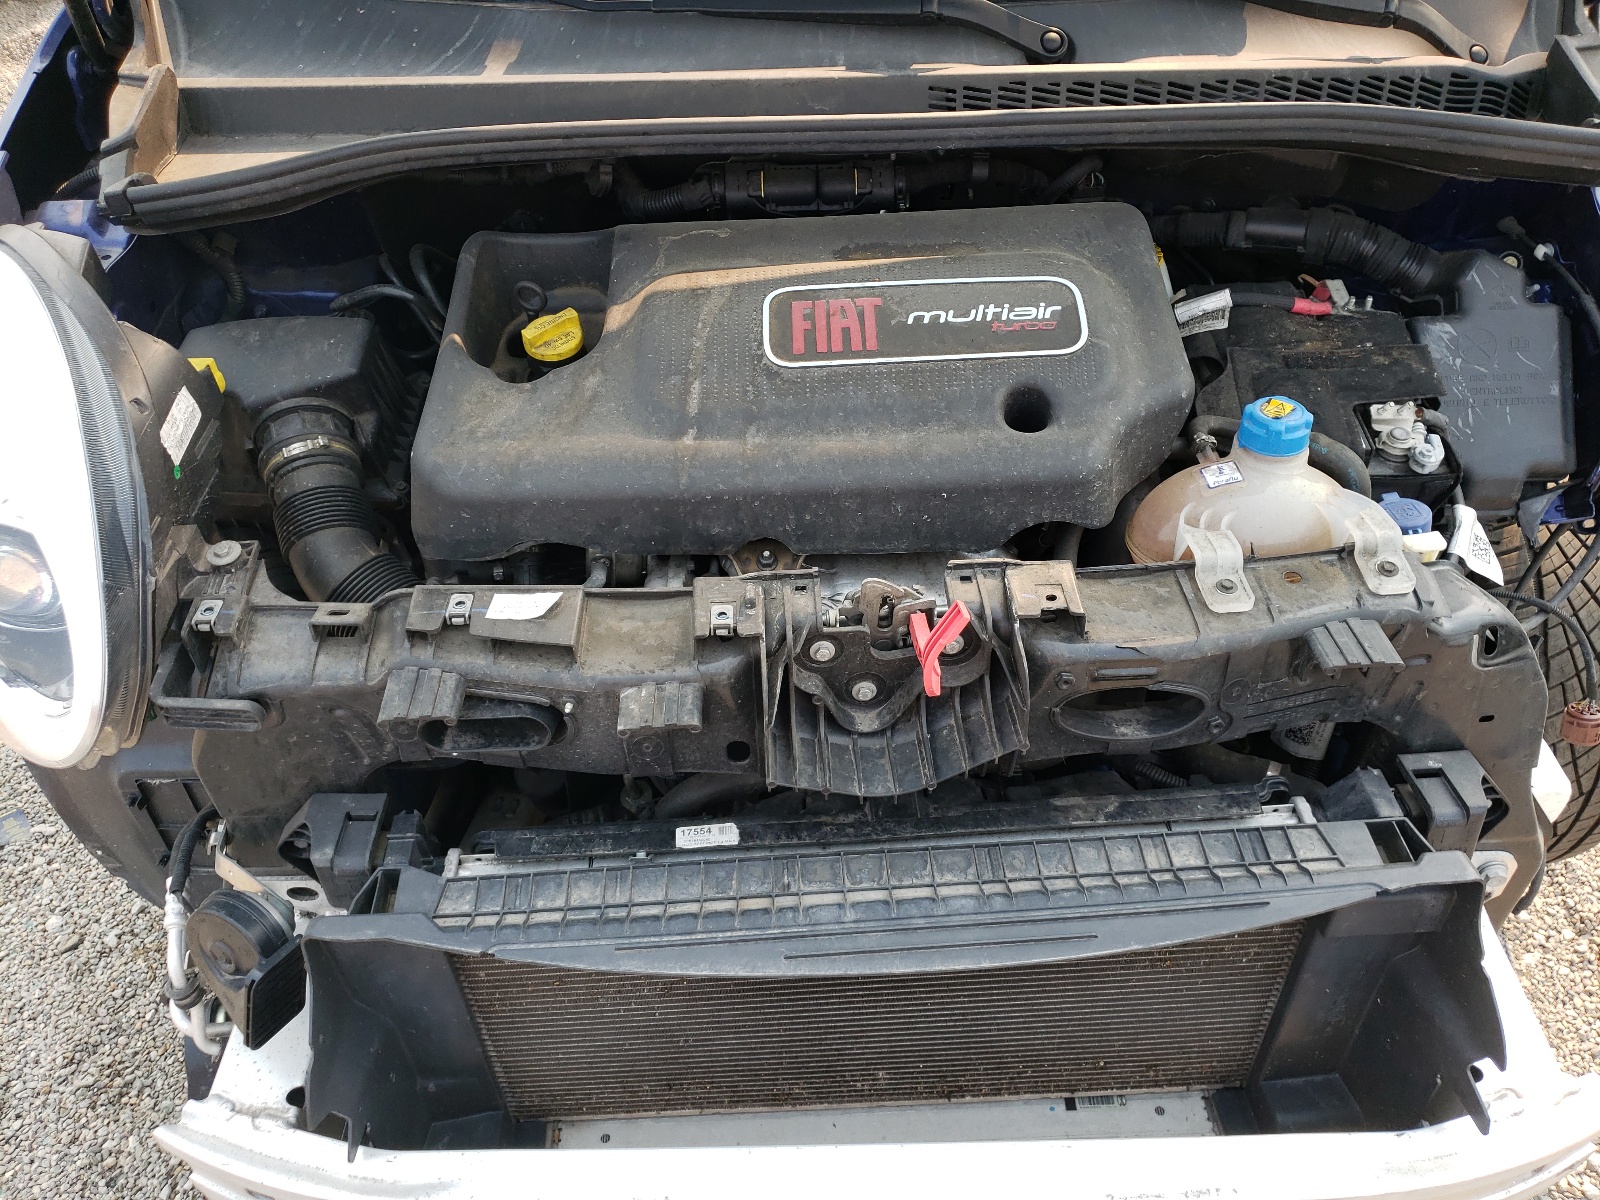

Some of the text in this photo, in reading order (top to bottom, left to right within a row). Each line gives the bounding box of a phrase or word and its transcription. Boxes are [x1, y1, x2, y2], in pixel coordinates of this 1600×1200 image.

[907, 303, 1062, 325] multiair
[791, 297, 882, 355] FIAT
[991, 320, 1058, 332] turbo
[681, 827, 712, 836] 17554
